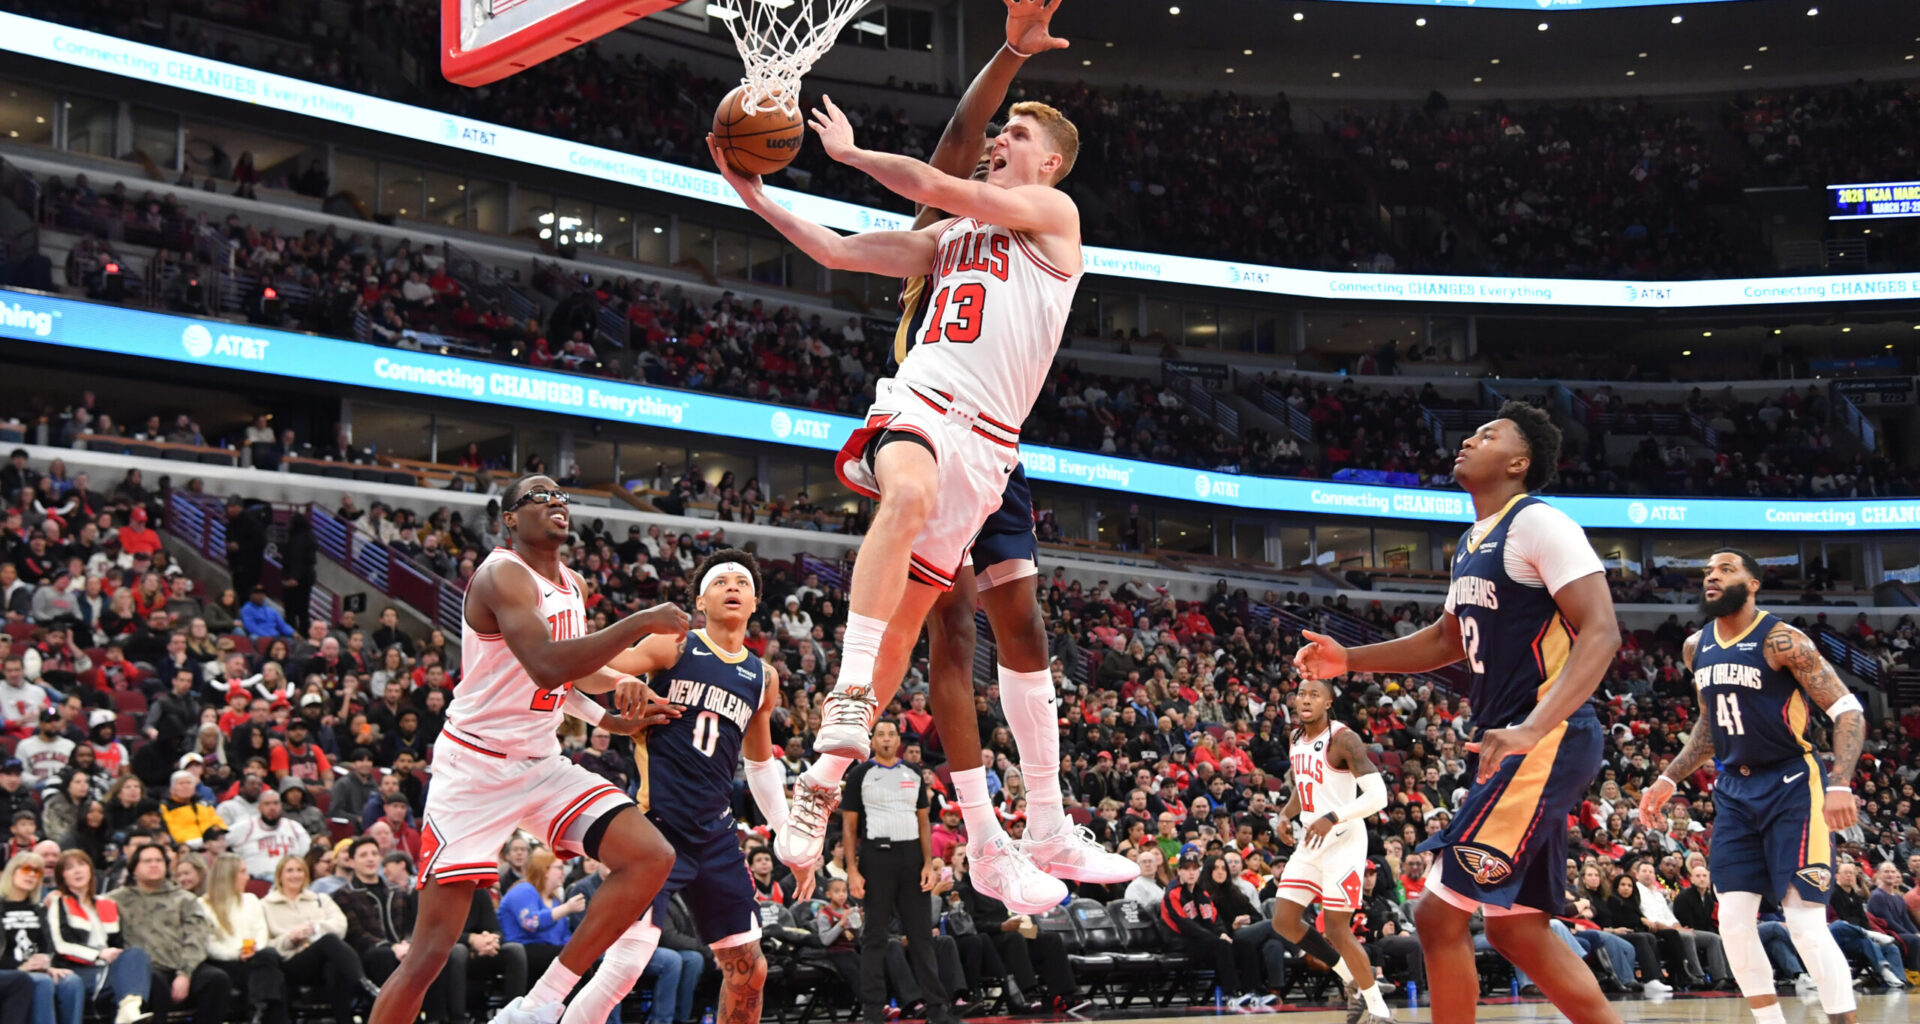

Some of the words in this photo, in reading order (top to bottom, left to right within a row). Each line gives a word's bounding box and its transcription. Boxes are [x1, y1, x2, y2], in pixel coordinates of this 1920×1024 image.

[53, 35, 159, 76] Connecting
[166, 60, 256, 95] CHANGES
[263, 82, 355, 119] Everything
[462, 127, 497, 146] AT&T
[569, 151, 647, 182] Connecting
[652, 167, 720, 196] CHANGES
[1838, 188, 1864, 203] 2026
[1865, 187, 1893, 202] NCAA
[1872, 201, 1900, 214] MARCH
[874, 217, 900, 231] AT&T
[1093, 254, 1161, 276] Everything
[1243, 271, 1270, 284] AT&T
[1329, 280, 1403, 296] Connecting
[1408, 281, 1475, 296] CHANGES
[1479, 284, 1552, 300] Everything
[1641, 288, 1672, 299] AT&T
[1743, 284, 1826, 298] Connecting
[1831, 280, 1907, 295] CHANGES
[922, 282, 986, 344] 13
[213, 334, 269, 360] AT&T
[374, 357, 484, 396] Connecting
[490, 373, 584, 407] CHANGES
[794, 419, 831, 439] AT&T
[1212, 481, 1240, 497] AT&T
[1312, 490, 1389, 513] Connecting
[1393, 493, 1462, 514] CHANGES
[1650, 506, 1687, 521] AT&T
[1765, 508, 1856, 527] Connecting
[1457, 576, 1498, 609] ORLEANS
[1713, 663, 1762, 690] ORLEANS
[666, 679, 706, 707] NEW
[704, 685, 752, 733] ORLEANS
[1716, 692, 1745, 735] 41
[693, 710, 720, 758] 0
[1298, 781, 1315, 813] 11
